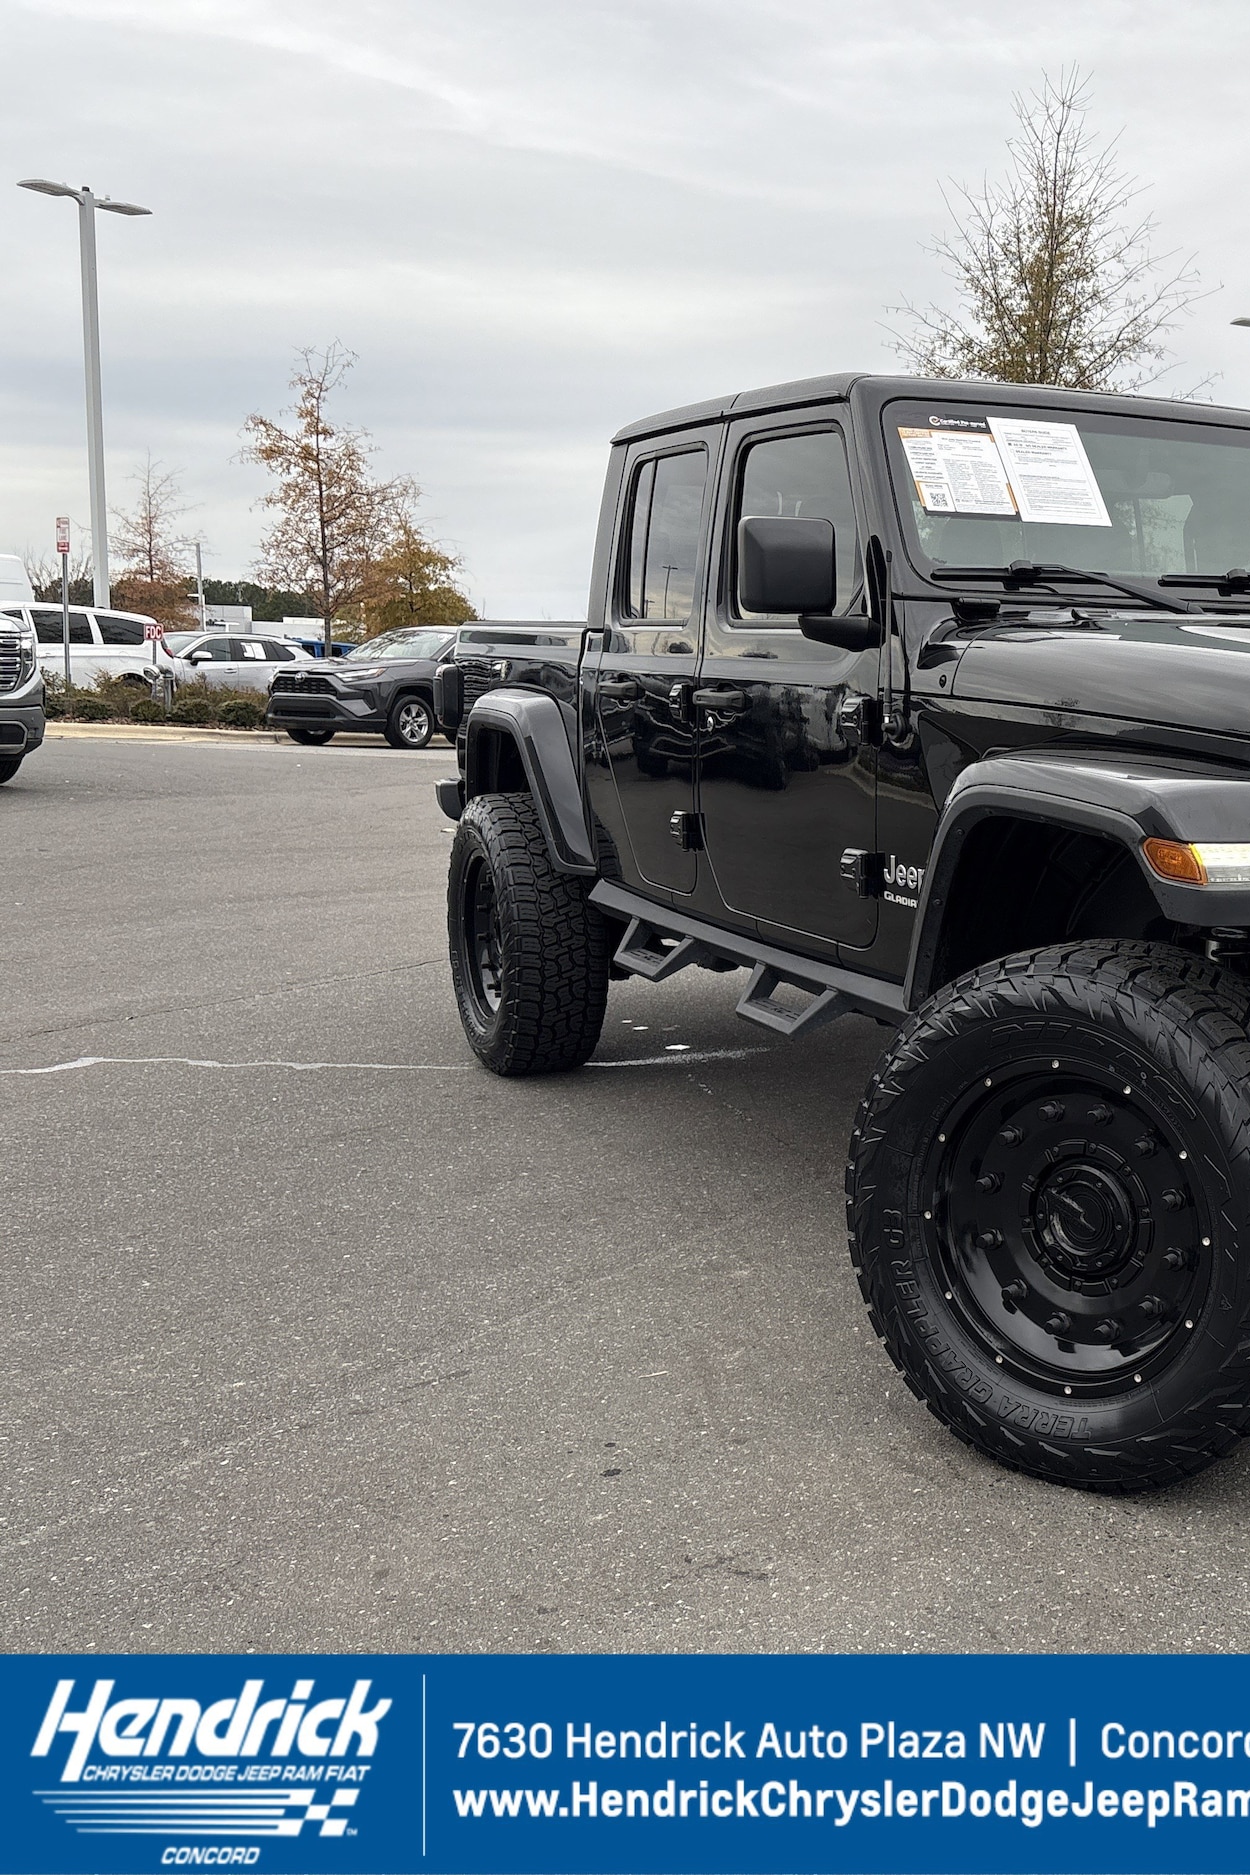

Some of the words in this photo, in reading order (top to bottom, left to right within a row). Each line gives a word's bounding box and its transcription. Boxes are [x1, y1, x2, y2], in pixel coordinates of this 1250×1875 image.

[145, 625, 162, 639] FDC
[883, 890, 919, 909] GLADIA
[890, 1260, 994, 1404] GRAPPLER
[997, 1396, 1091, 1440] TERRA
